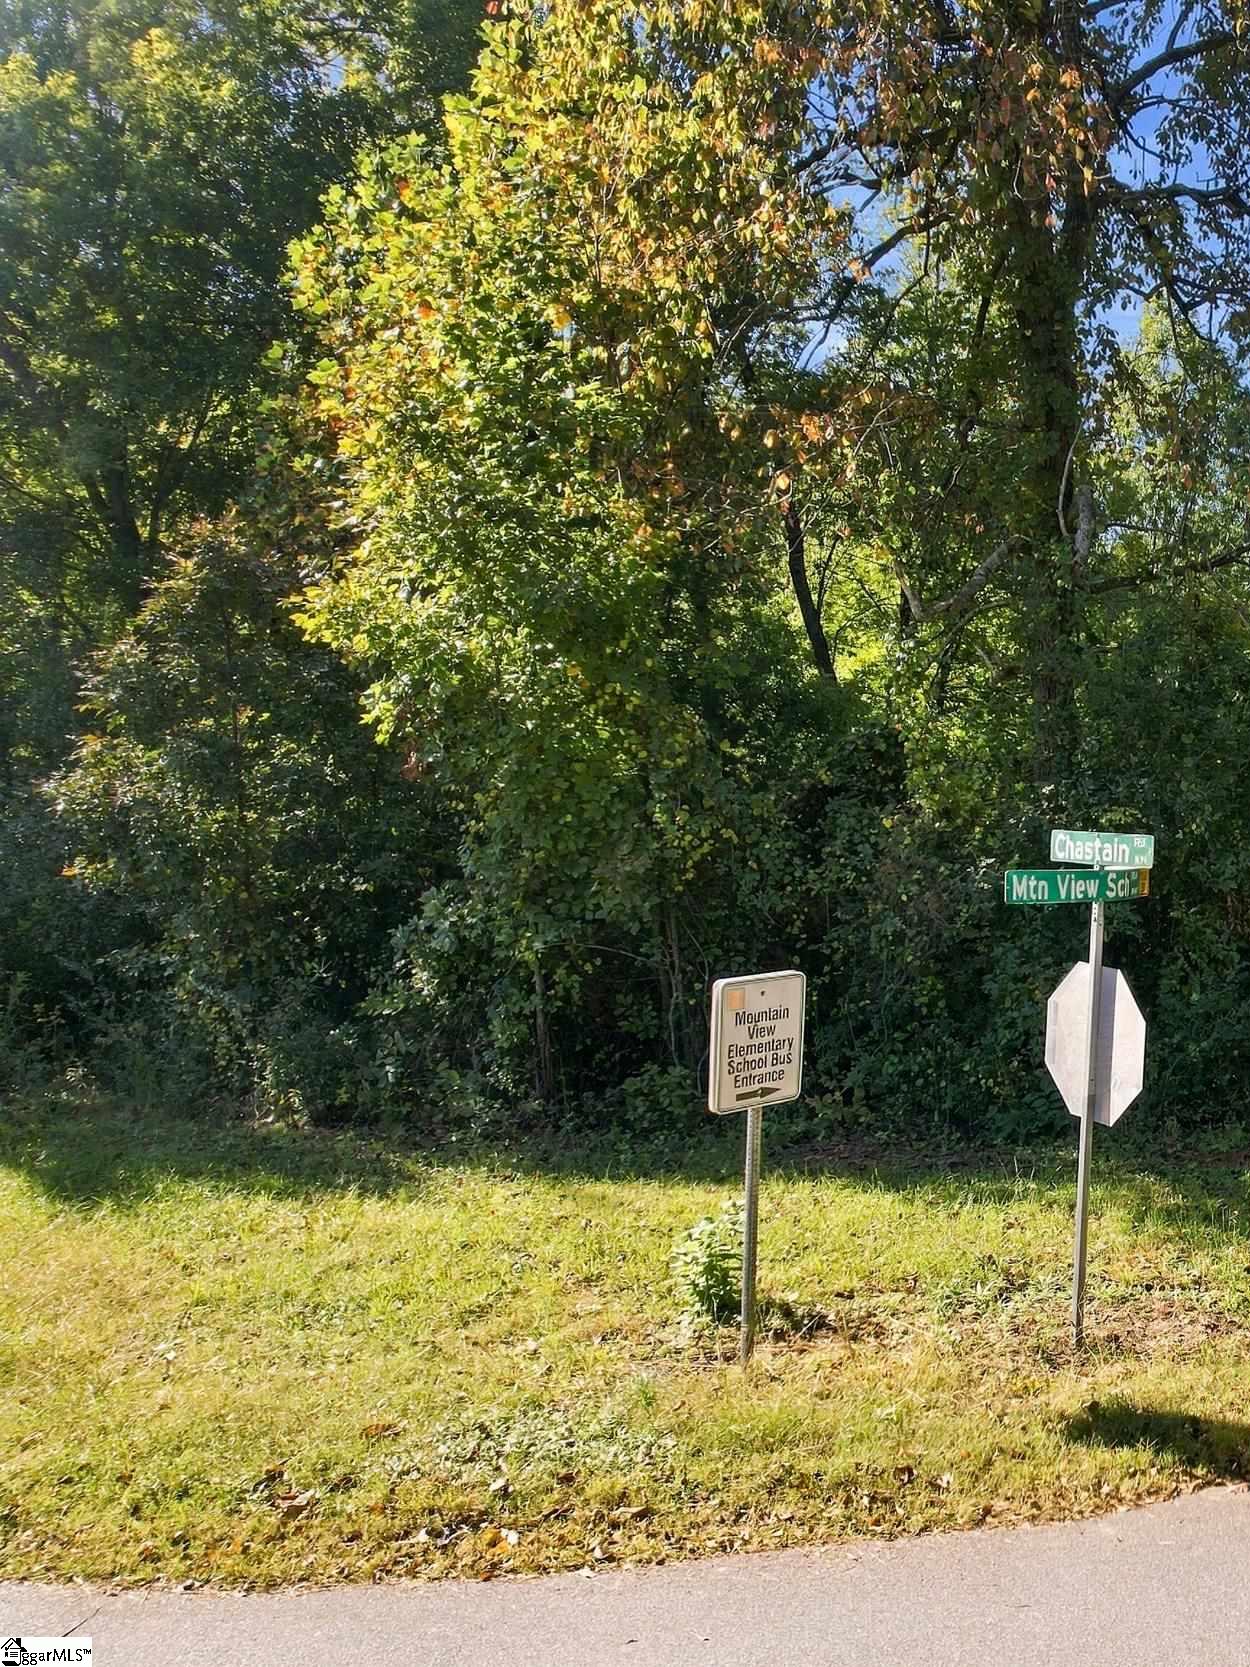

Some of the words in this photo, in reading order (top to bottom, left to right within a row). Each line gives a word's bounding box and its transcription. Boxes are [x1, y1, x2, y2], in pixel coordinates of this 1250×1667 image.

[1055, 834, 1129, 863] Chastain
[1012, 874, 1049, 900] Mtn
[1057, 874, 1099, 899] View
[1106, 870, 1130, 898] Sch
[735, 1005, 790, 1026] Mountain
[748, 1024, 777, 1040] View
[728, 1037, 795, 1059] Elementary
[728, 1057, 768, 1075] School
[771, 1052, 793, 1066] Bus
[734, 1068, 785, 1089] Entrance
